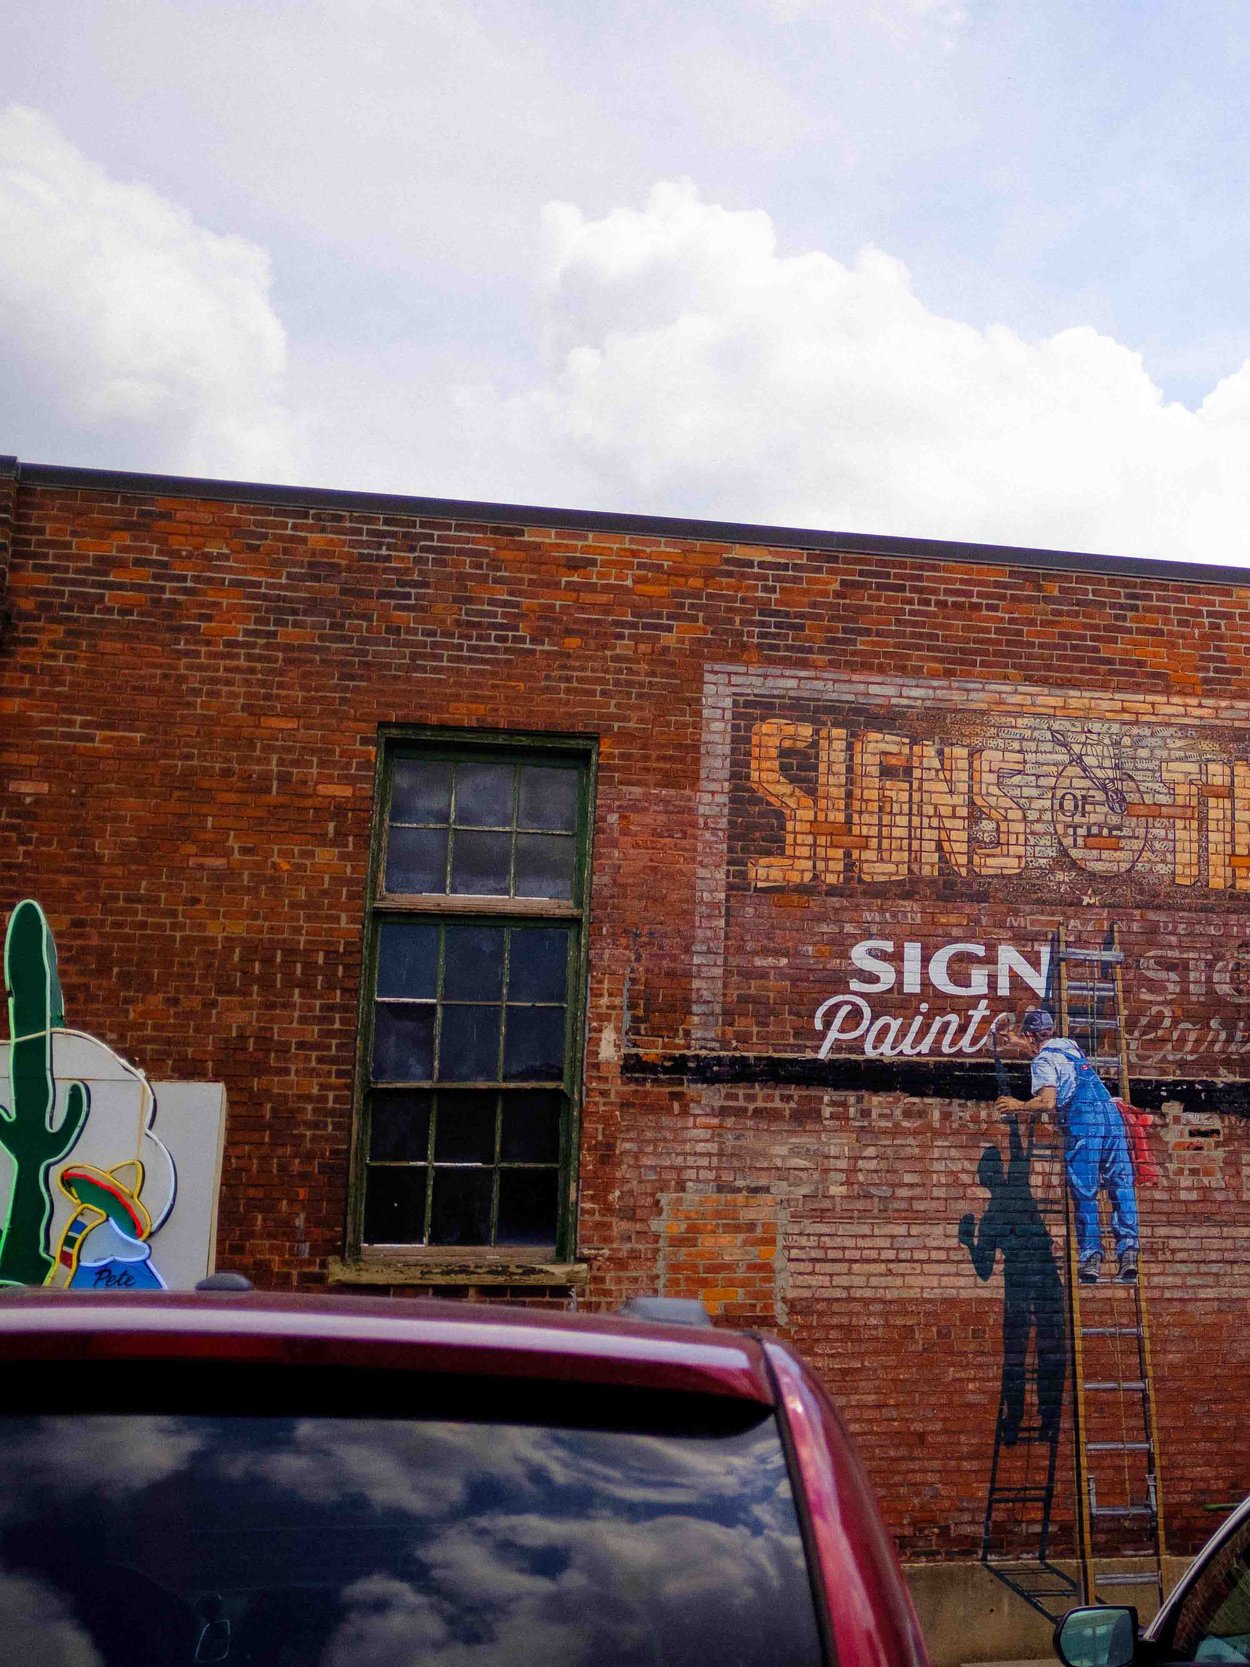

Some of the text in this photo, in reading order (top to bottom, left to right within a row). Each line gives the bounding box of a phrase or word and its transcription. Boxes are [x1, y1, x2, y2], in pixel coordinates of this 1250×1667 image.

[748, 718, 1026, 887] SIGNS
[1058, 791, 1098, 818] OF
[849, 939, 1053, 998] SIGN
[92, 1268, 136, 1289] Pete
